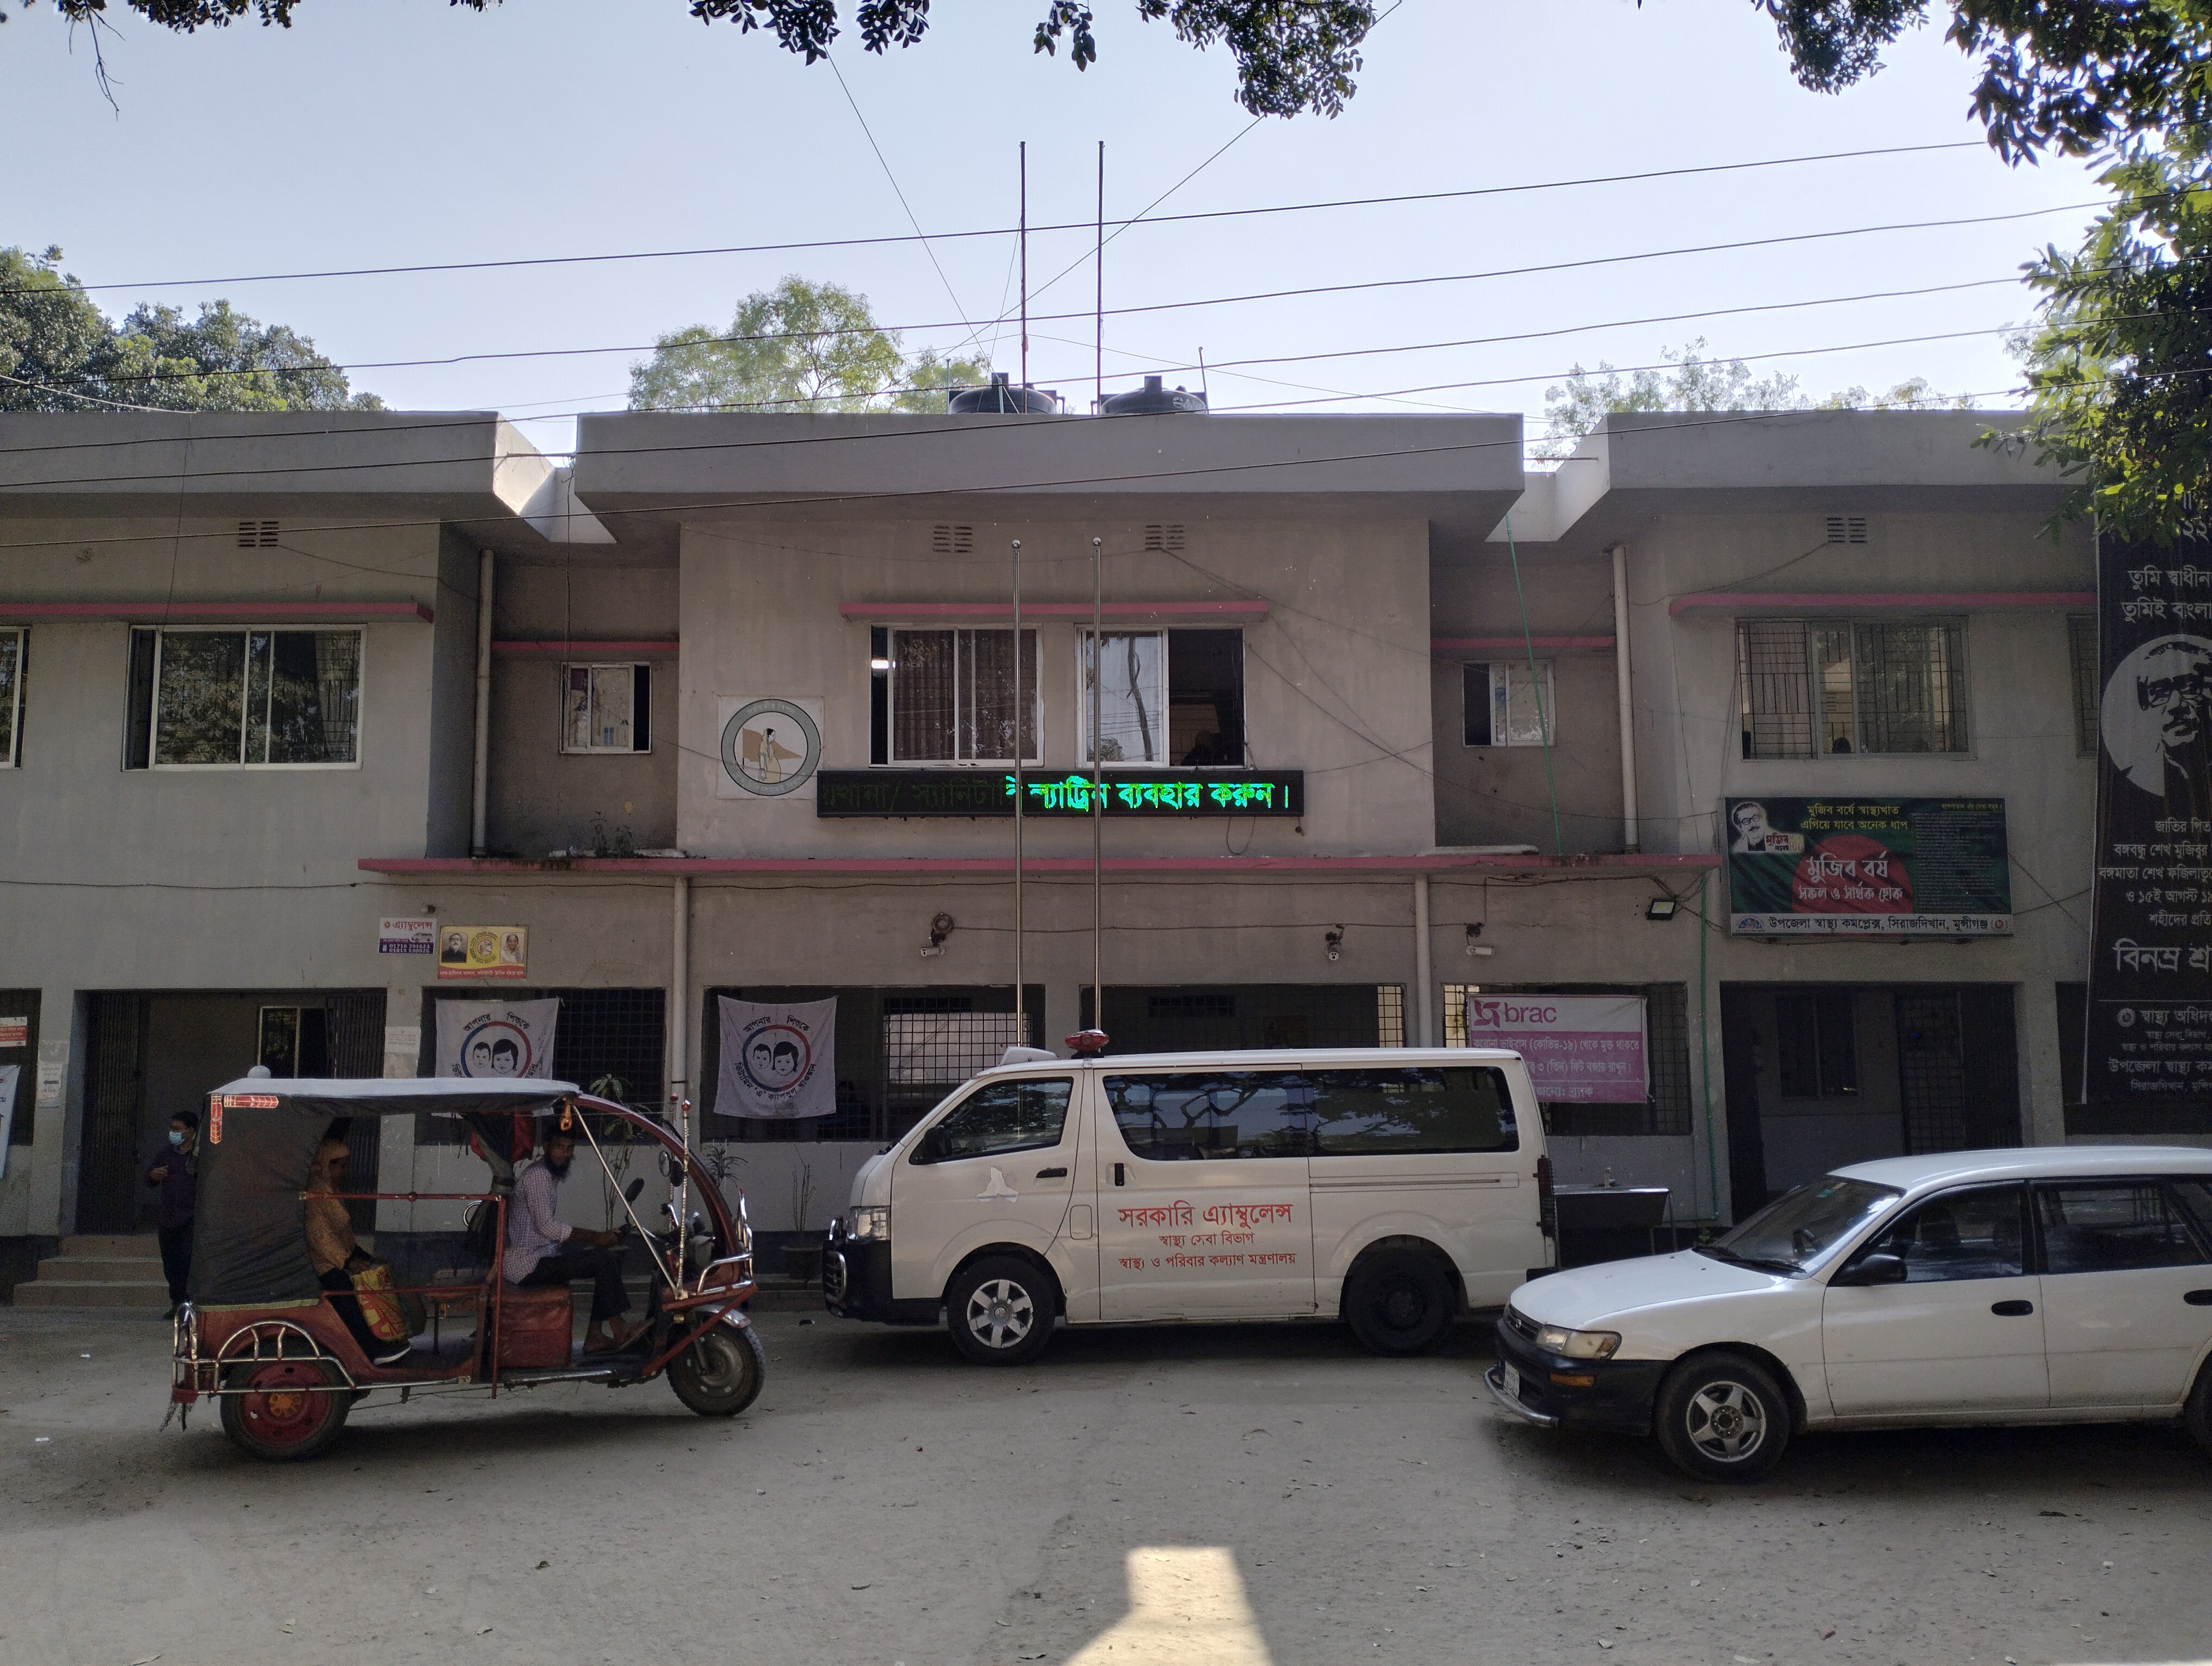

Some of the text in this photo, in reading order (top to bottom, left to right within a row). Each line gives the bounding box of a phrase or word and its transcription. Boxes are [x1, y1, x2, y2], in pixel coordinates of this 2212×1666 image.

[2127, 565, 2212, 592] তুমি স্বাধীন
[2120, 597, 2168, 624] তুমিই
[1115, 781, 1204, 810] ব্যবহার
[1208, 783, 1275, 809] করুন
[1807, 803, 1834, 817] মুজিব
[1801, 818, 1909, 830] এগিয়ে যাবে অনেক ধাপ
[2155, 817, 2188, 833] জাতির
[2113, 840, 2208, 860] বঙ্গবন্ধু শেখ মুজিবুর
[1806, 850, 1888, 884] মুজিব বর্ষ
[2098, 867, 2139, 880] বঙ্গমাতা
[2143, 866, 2165, 880] শেখ
[1831, 888, 1840, 900] ও
[1844, 881, 1874, 900] সার্থক
[1879, 886, 1903, 902] হোক
[2126, 891, 2134, 902] ও
[2138, 887, 2163, 903] ১৫ই
[2164, 887, 2199, 903] আগস্ট
[1769, 916, 1810, 929] উপজেলা
[1814, 918, 1838, 931] স্বাস্থ্য
[1888, 915, 1950, 931] সিরাজদিখান,
[2149, 909, 2189, 927] শহীদের
[2112, 937, 2183, 973] বিনম্র
[1504, 1002, 1558, 1023] brac
[2139, 1010, 2170, 1026] স্বাস্থ্য
[463, 1014, 491, 1031] আপনার
[743, 1016, 772, 1033] আপনার
[1580, 1039, 1599, 1051] থেকে
[2108, 1056, 2162, 1074] উপজেলা
[2164, 1061, 2192, 1075] স্বাস্থ্য
[1117, 1200, 1294, 1230] সরকারি এ্যাম্বুলেন্স
[1159, 1230, 1256, 1249] স্বাস্থ্য সেবা বিভাগ
[1118, 1253, 1297, 1272] স্বাস্থ্য ও পরিবার কল্যাণ মন্ত্রণালয়
